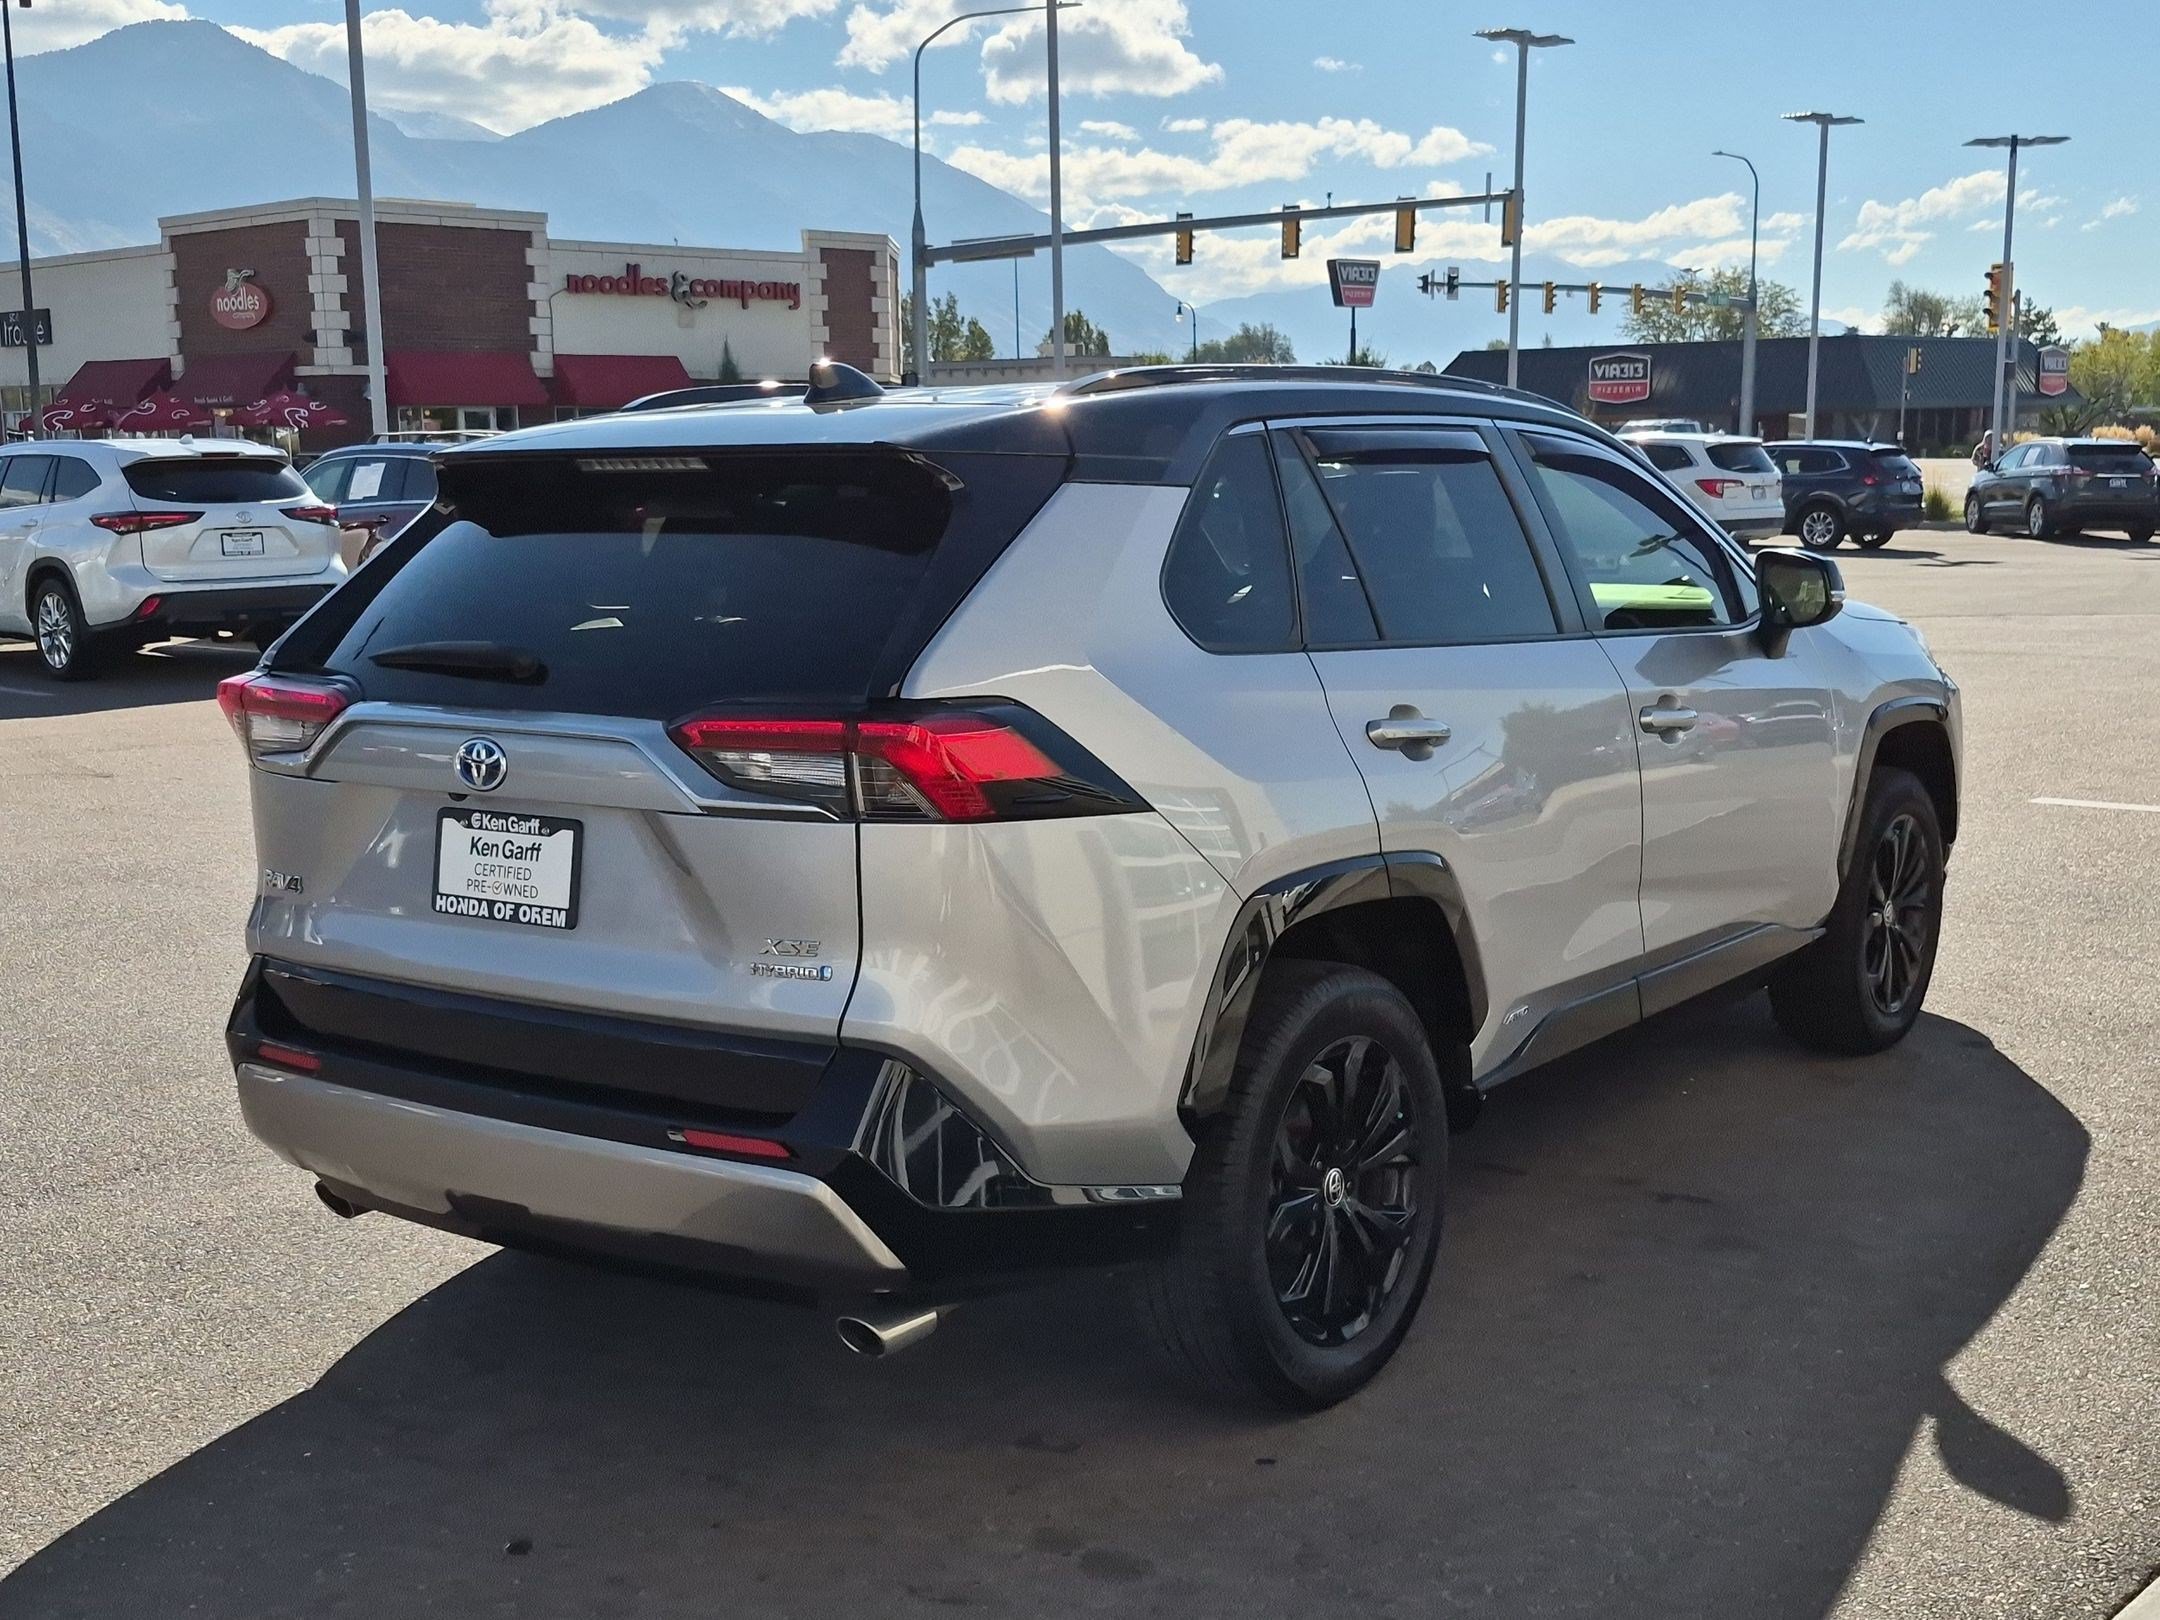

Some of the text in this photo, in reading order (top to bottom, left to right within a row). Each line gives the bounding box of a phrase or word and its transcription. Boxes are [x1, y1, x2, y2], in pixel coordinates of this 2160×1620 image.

[216, 286, 260, 312] noodles
[566, 263, 669, 296] noodles
[689, 279, 800, 310] company
[482, 813, 507, 831] Ken
[508, 816, 540, 834] Garff
[469, 836, 542, 862] Ken Garff
[264, 868, 303, 894] RAV4
[474, 862, 532, 881] CERTIFIED
[436, 894, 567, 928] HONDA OF OREM
[759, 937, 820, 957] XSE
